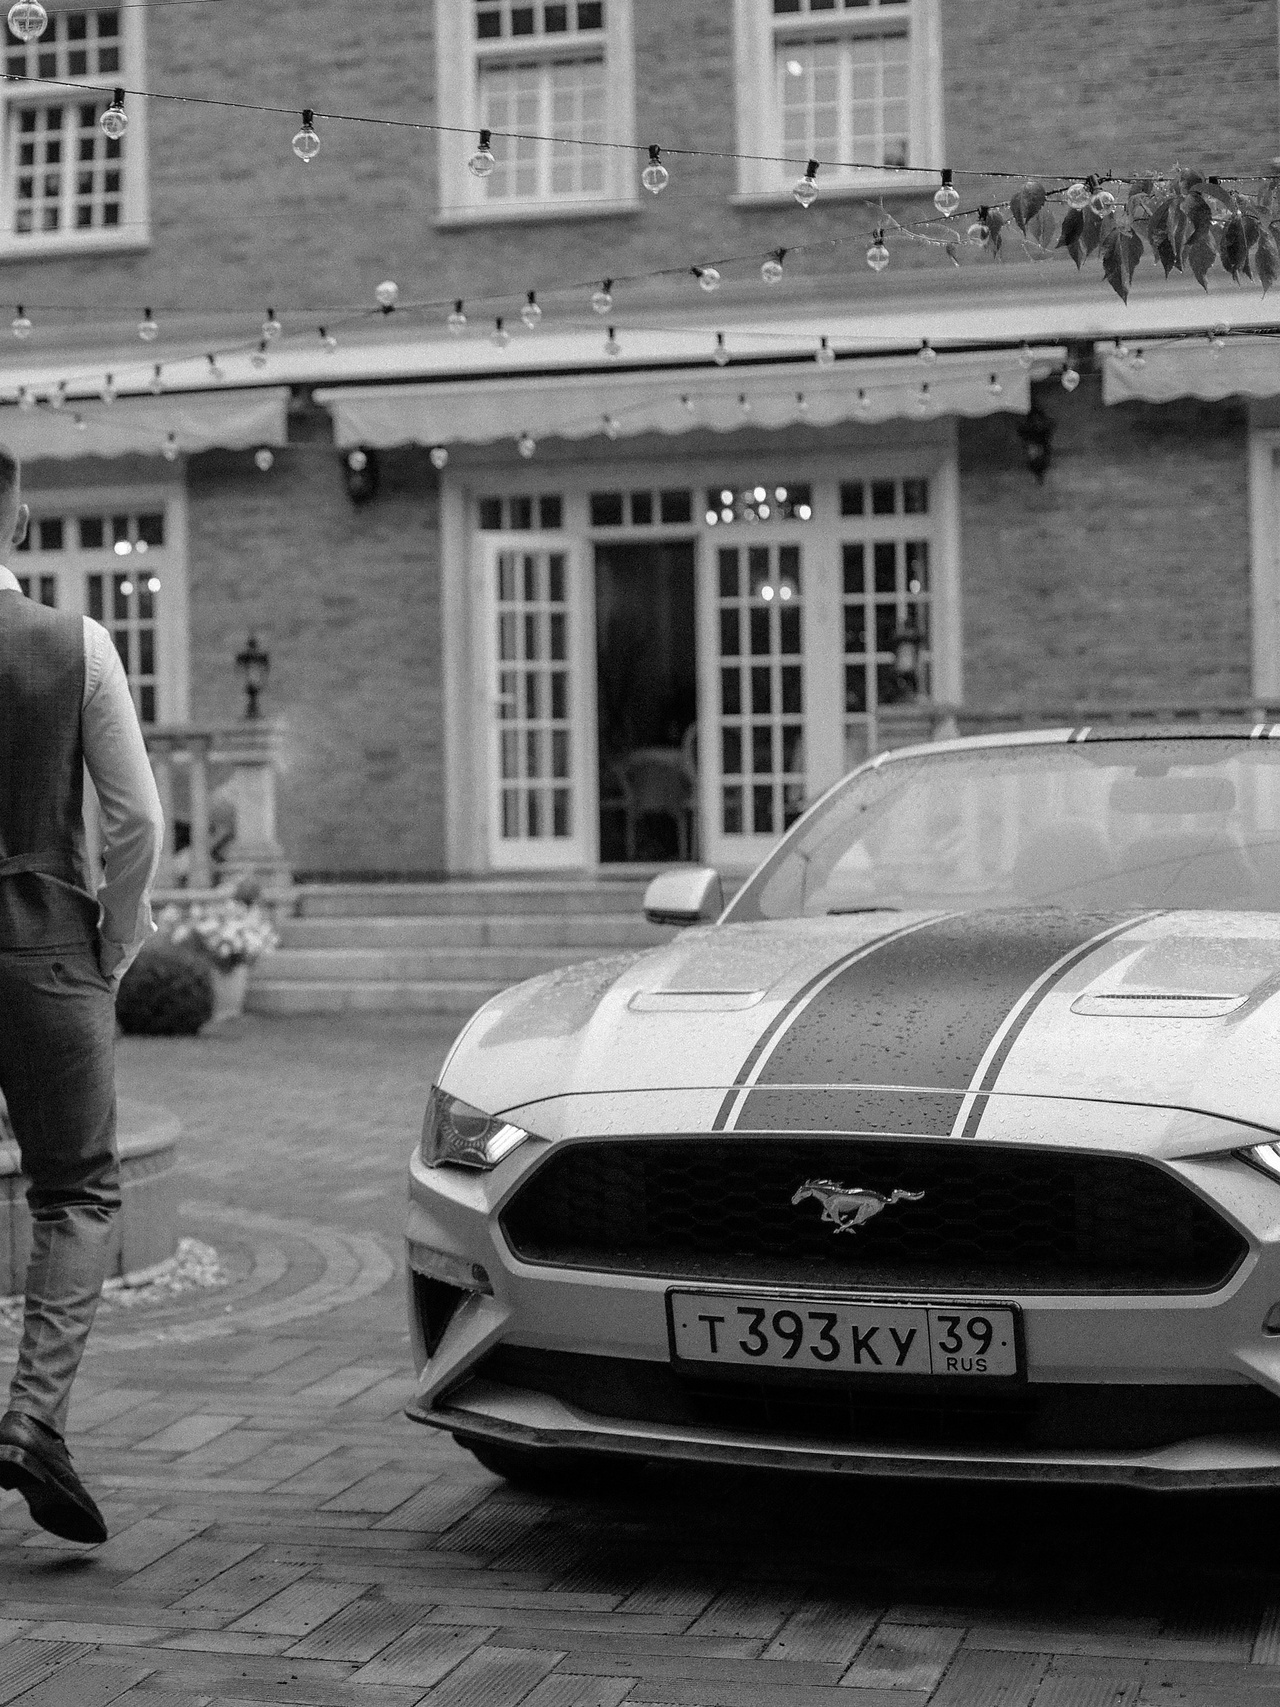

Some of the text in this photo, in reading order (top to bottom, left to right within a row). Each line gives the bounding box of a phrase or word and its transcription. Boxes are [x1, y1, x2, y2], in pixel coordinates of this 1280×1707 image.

[698, 1307, 994, 1366] T393KY 39
[946, 1357, 988, 1373] RUS
